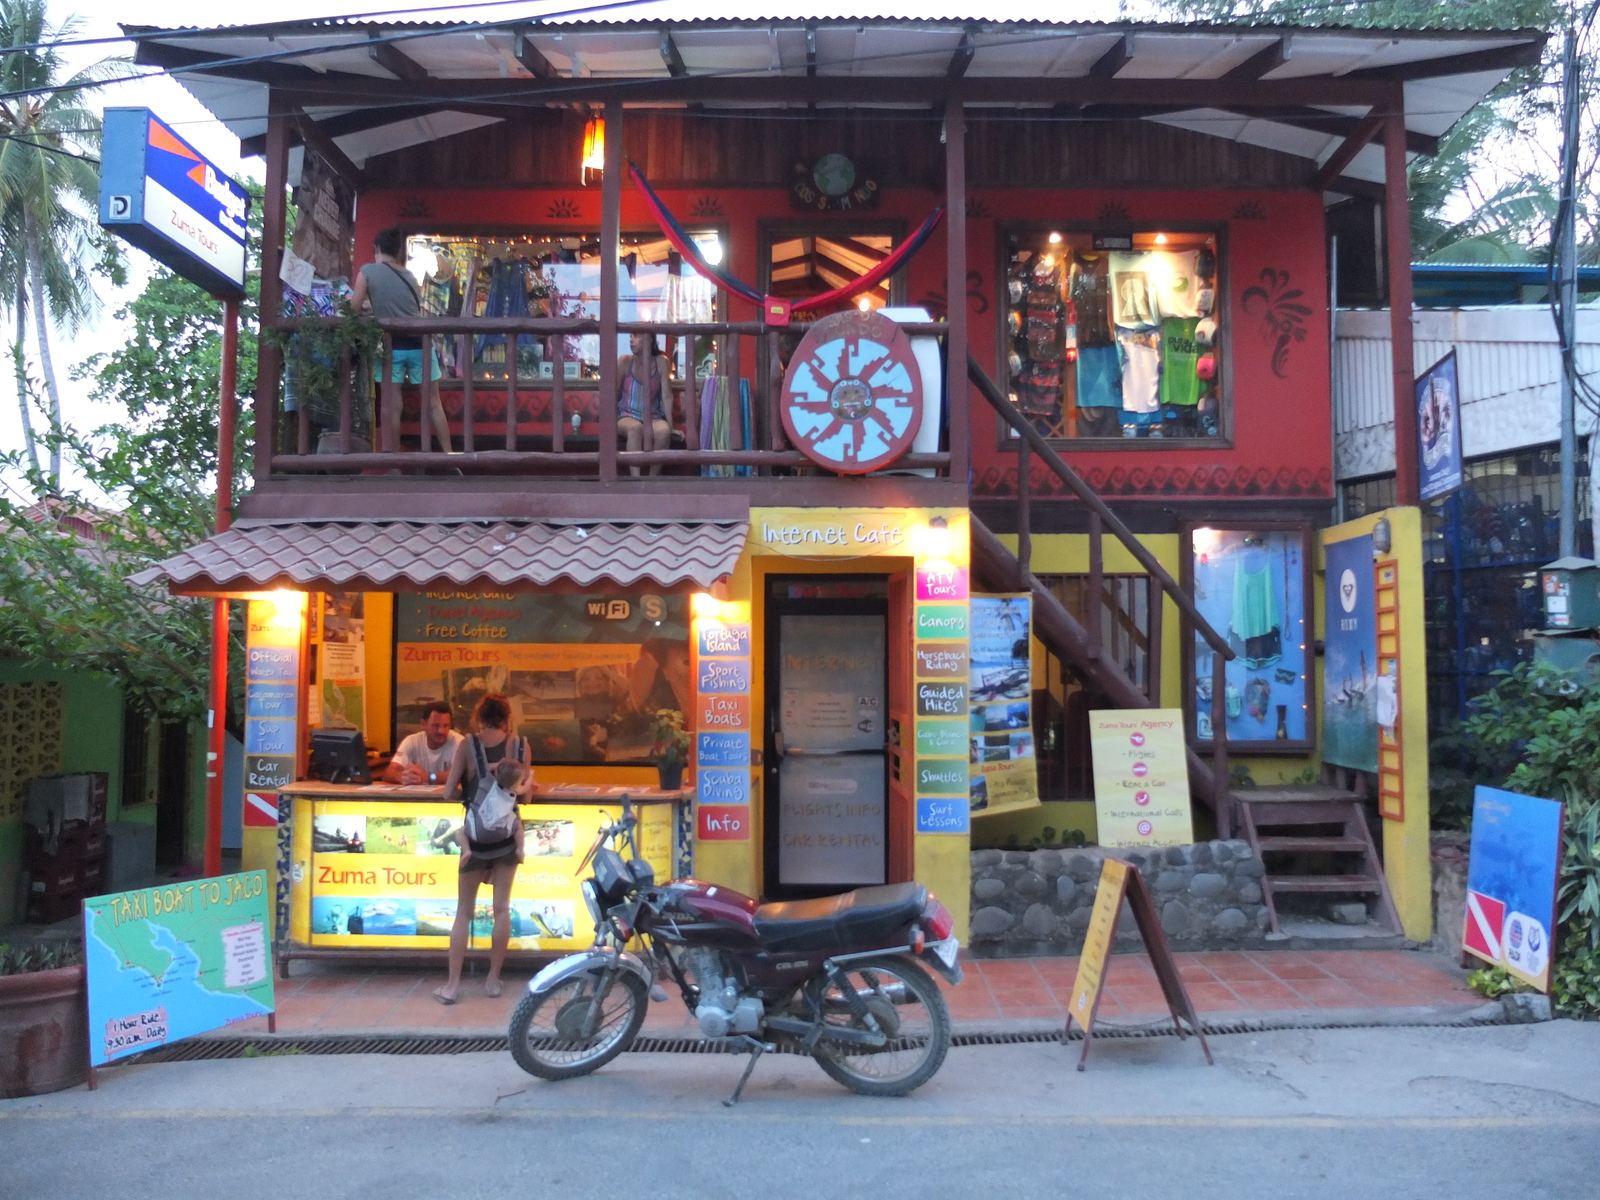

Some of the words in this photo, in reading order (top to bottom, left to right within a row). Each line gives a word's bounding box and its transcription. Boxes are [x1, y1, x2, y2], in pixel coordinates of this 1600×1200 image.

[171, 210, 196, 238] Zuma
[197, 228, 218, 254] Tours
[764, 523, 848, 545] Internet
[854, 523, 904, 544] Cafe
[926, 570, 955, 583] ATV
[926, 582, 956, 596] Tours
[919, 613, 965, 630] Canopy
[1340, 618, 1358, 631] ROXY
[425, 624, 457, 638] Free
[461, 624, 508, 639] Coffee
[700, 625, 748, 642] Tortuga
[706, 637, 741, 652] Island
[251, 651, 294, 663] Official
[404, 647, 452, 662] Zuma
[456, 647, 501, 662] Tours
[917, 650, 966, 661] Horseback
[782, 654, 878, 671] INTERNET
[926, 659, 958, 672] Riding
[707, 662, 740, 679] Sport
[701, 676, 747, 691] Fishing
[248, 690, 295, 700] Catamaran
[919, 685, 964, 700] Guided
[258, 698, 282, 710] Tour
[709, 696, 738, 710] Taxi
[859, 697, 877, 706] A/C
[925, 698, 958, 713] Hikes
[705, 709, 742, 726] Boats
[1098, 722, 1118, 730] Zuma
[1140, 720, 1174, 730] Agency
[259, 720, 280, 737] Sup
[257, 738, 285, 752] Tour
[703, 736, 744, 749] Private
[699, 750, 718, 761] Boat
[722, 750, 748, 762] Tours
[1128, 750, 1155, 759] Flights
[257, 758, 279, 772] Car
[249, 772, 291, 785] Rental
[704, 770, 743, 787] Scuba
[921, 769, 963, 784] Shuttles
[1122, 780, 1143, 788] Rent
[1151, 780, 1166, 788] Car
[703, 785, 744, 800] Diving
[783, 803, 842, 818] FLIGHTS
[846, 803, 882, 816] INFO
[929, 803, 954, 816] Surf
[1110, 809, 1162, 818] International
[1164, 808, 1183, 818] Calls
[707, 814, 740, 832] Info
[920, 813, 963, 828] Lessons
[783, 832, 812, 847] CAR
[818, 833, 880, 847] RENTAL
[318, 865, 377, 885] Zuma
[383, 866, 437, 885] Tours
[111, 891, 149, 928] TAXI
[153, 884, 195, 917] BOAT
[199, 882, 221, 910] TO
[224, 873, 263, 906] JACO
[140, 1012, 161, 1026] Ride
[146, 1026, 167, 1038] Daily
